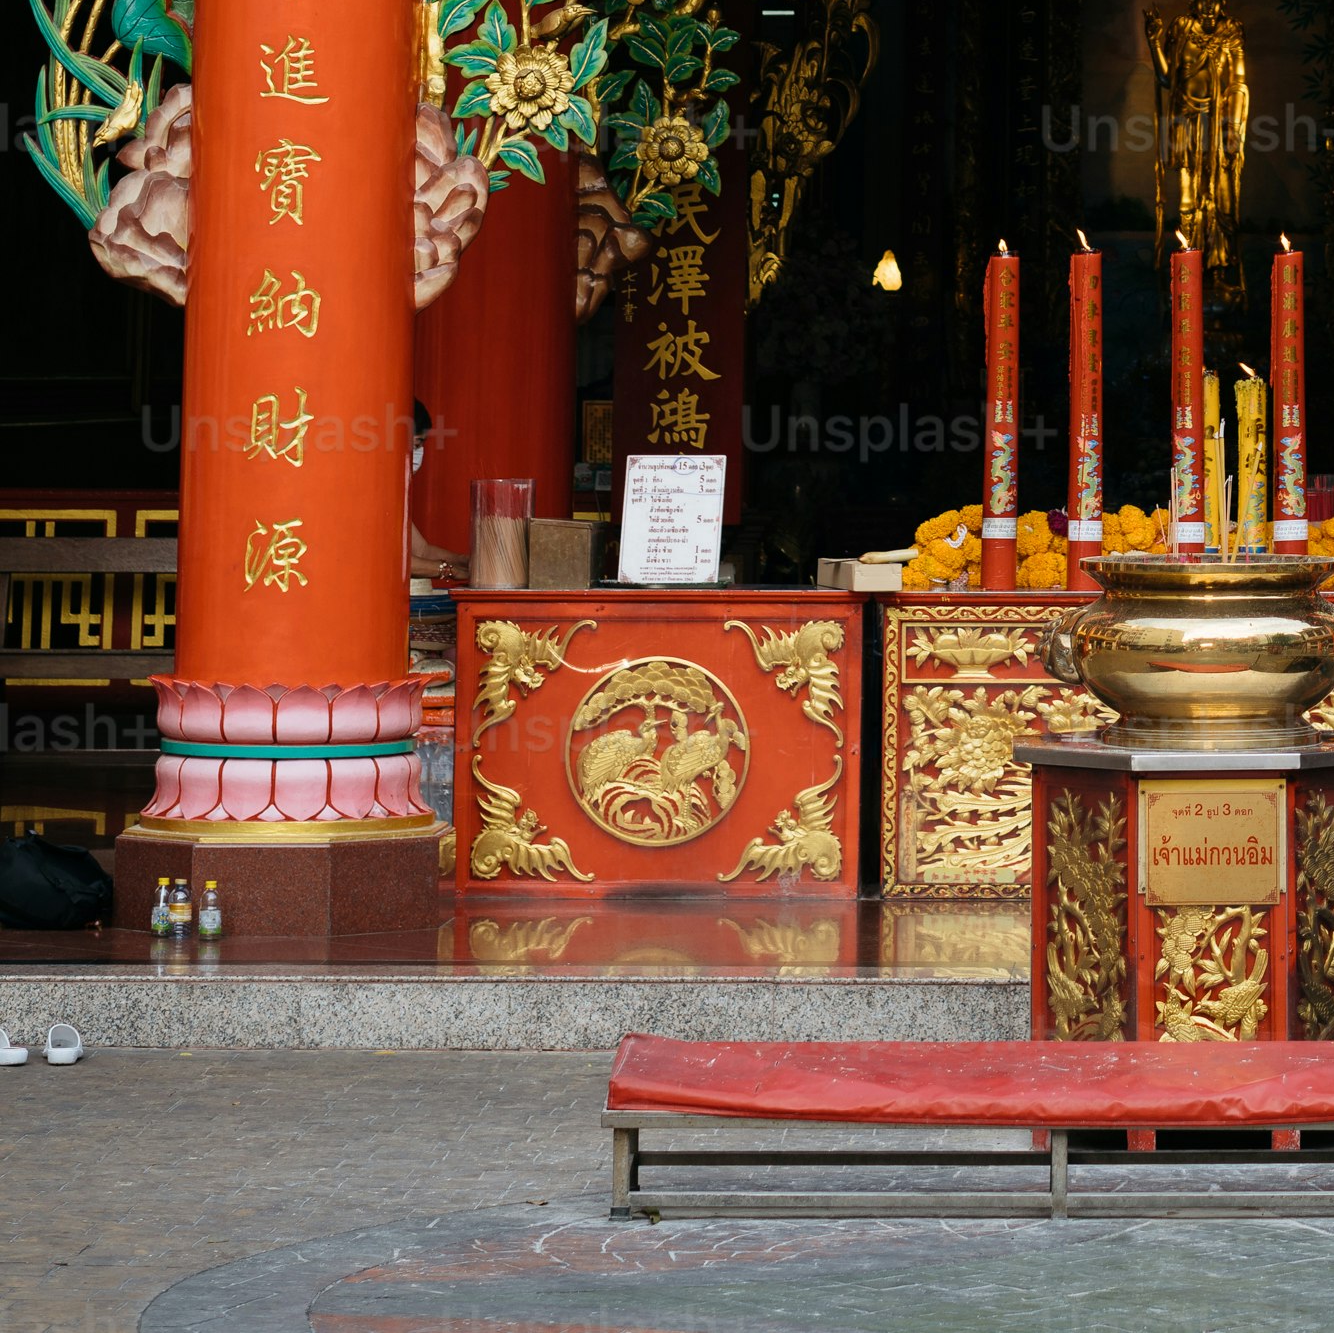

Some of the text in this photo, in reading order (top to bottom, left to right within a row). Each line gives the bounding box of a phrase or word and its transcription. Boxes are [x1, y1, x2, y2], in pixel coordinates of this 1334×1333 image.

[679, 462, 687, 470] 15
[699, 475, 705, 483] 5
[699, 485, 704, 493] 3
[697, 515, 702, 523] 5
[1172, 803, 1253, 819] จุดที่ 2 ธูป 3 ดอก
[1153, 835, 1273, 866] เจ้าแม่กวนอิม
